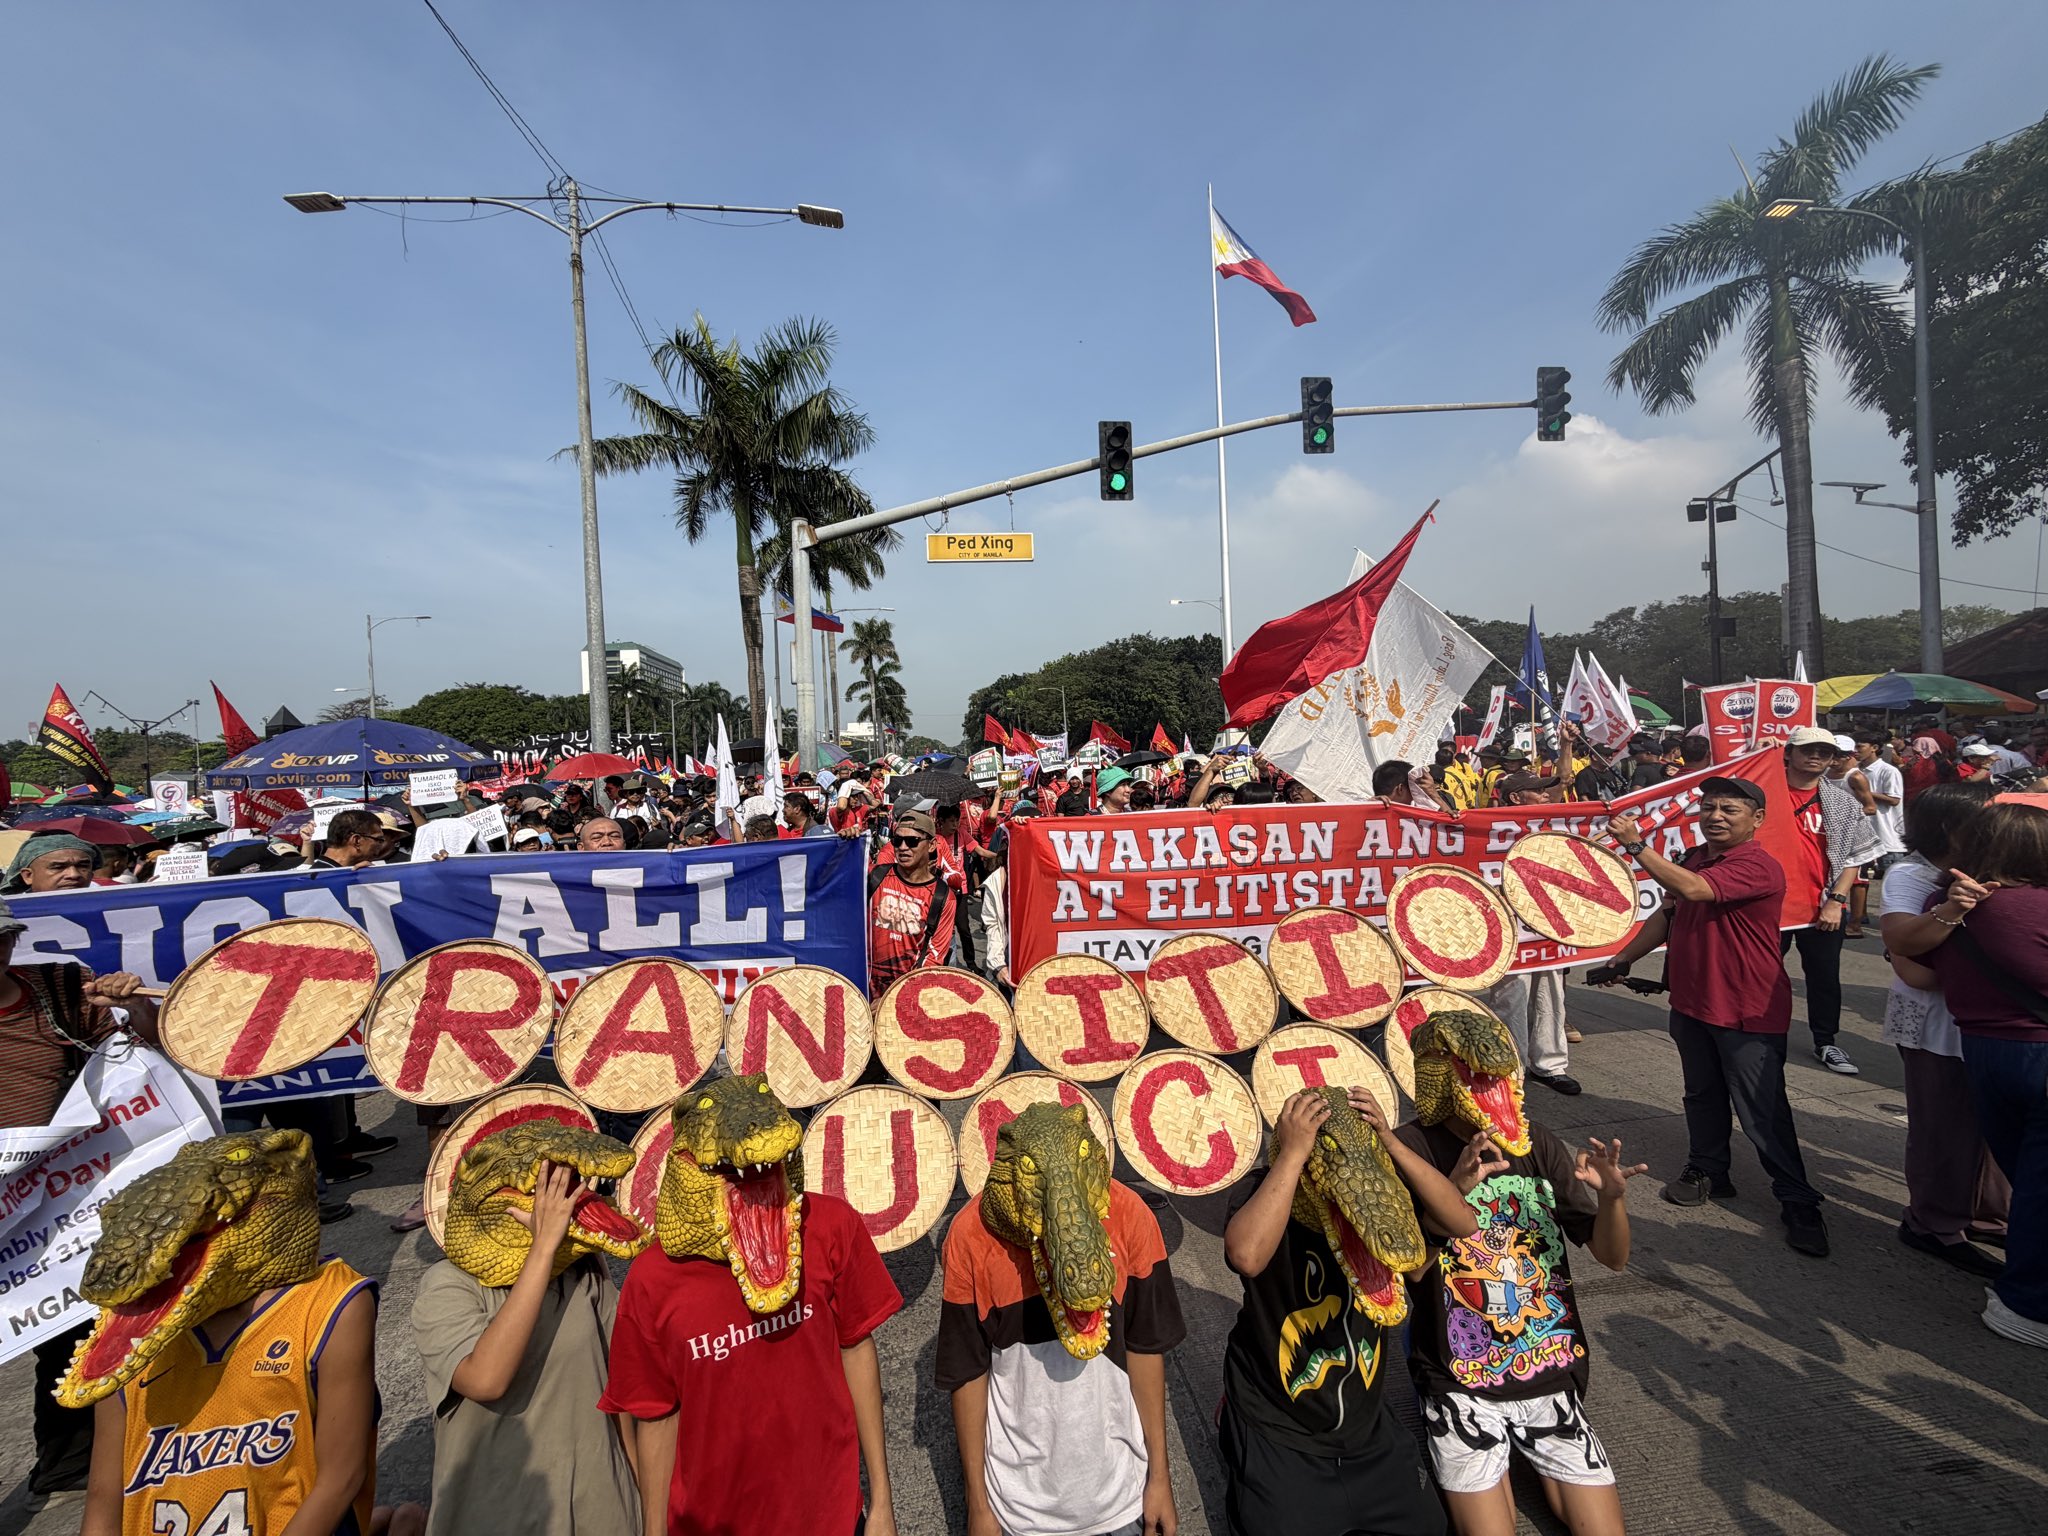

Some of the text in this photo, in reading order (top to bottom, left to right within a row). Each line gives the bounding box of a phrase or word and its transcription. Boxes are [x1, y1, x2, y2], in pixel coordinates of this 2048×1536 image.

[947, 536, 1014, 552] Ped Xing
[45, 741, 88, 768] MAHIHIRAP
[413, 774, 447, 783] TUMAHOL
[1048, 820, 1339, 873] WAKASAN
[1356, 818, 1466, 862] ANG
[490, 854, 808, 958] ALL!
[1051, 879, 1124, 922] AT
[45, 1150, 112, 1199] Day
[8, 1285, 84, 1338] MGA
[687, 1301, 814, 1361] Hghmnds
[253, 1359, 290, 1374] bibigo
[124, 1409, 301, 1497] LAKERS
